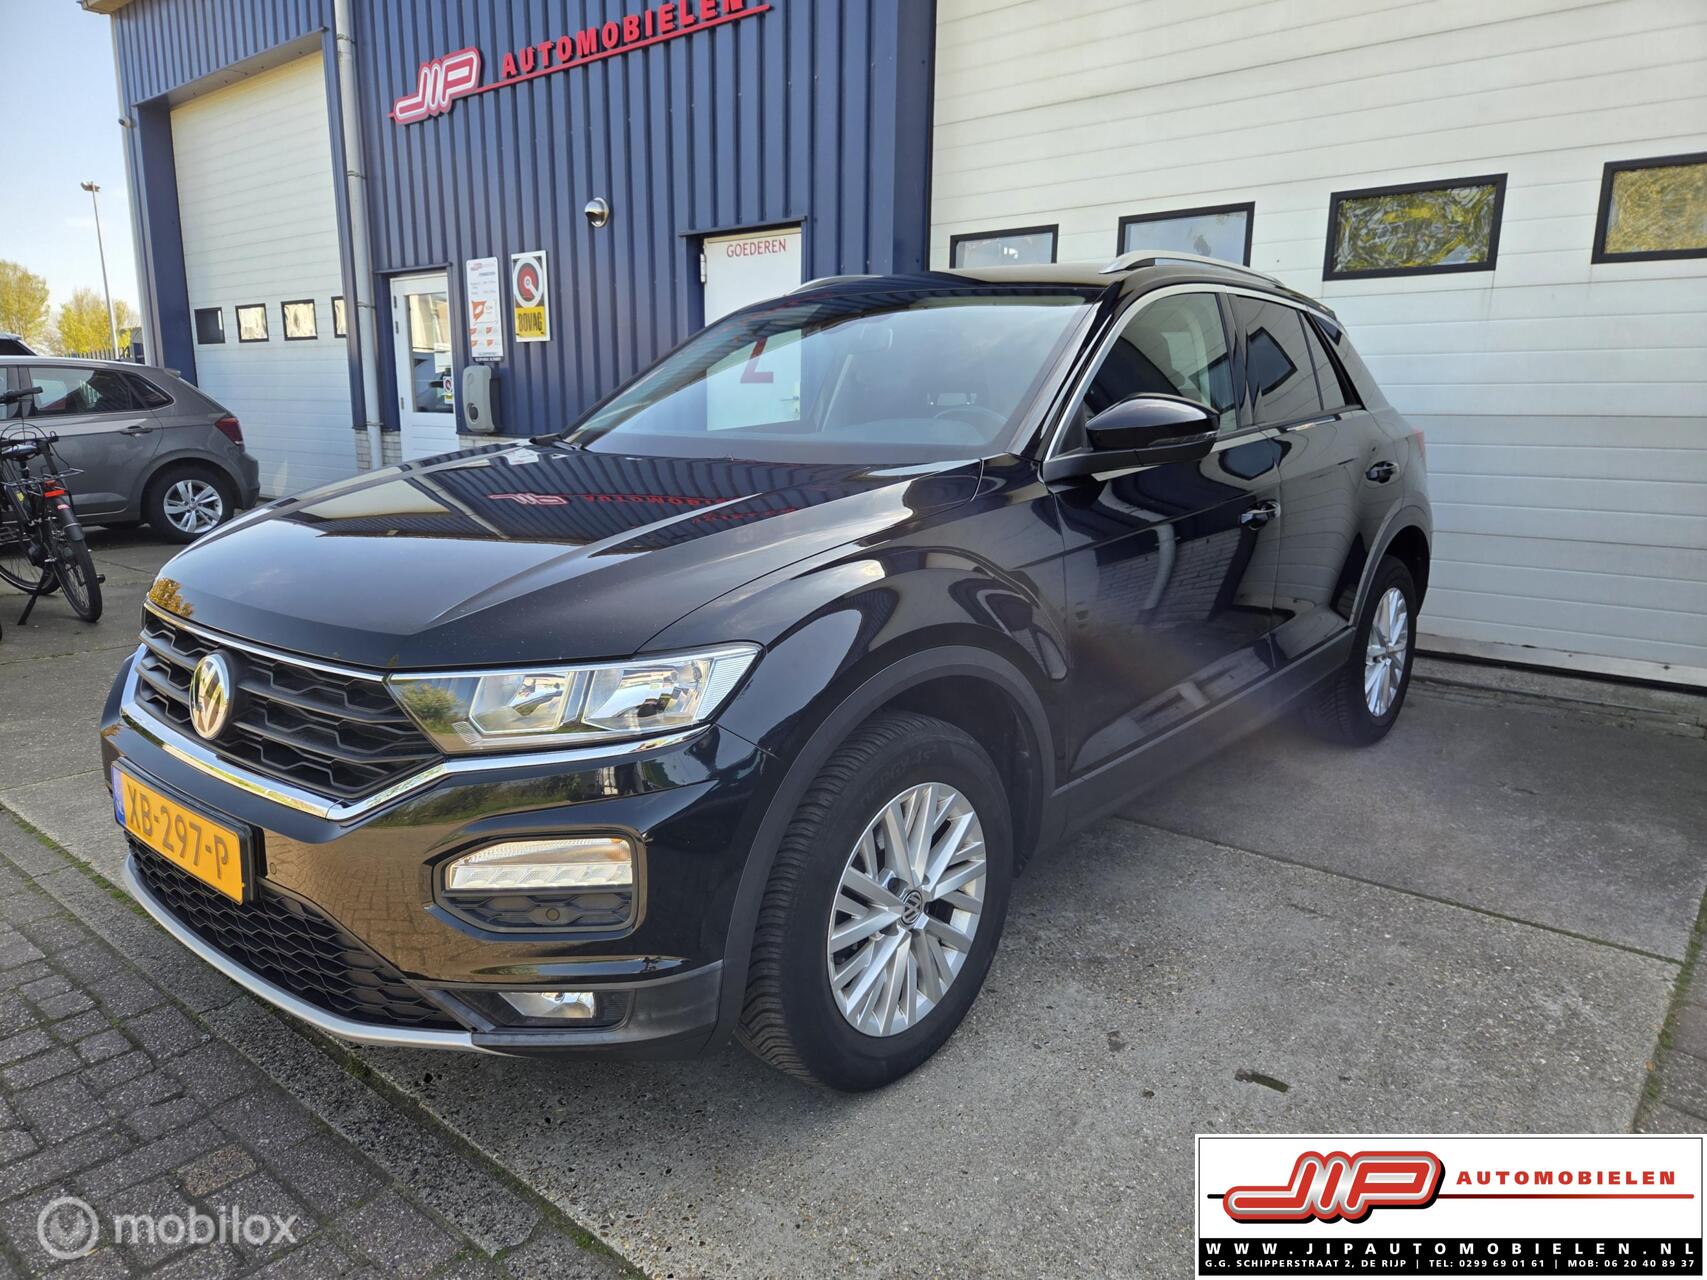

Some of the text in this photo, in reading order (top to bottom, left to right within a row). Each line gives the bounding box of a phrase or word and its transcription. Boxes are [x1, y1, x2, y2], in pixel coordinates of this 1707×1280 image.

[394, 47, 481, 124] JIP
[727, 239, 786, 257] GOEDEREN
[517, 311, 543, 332] BOVAG
[127, 783, 230, 880] XB-297-P
